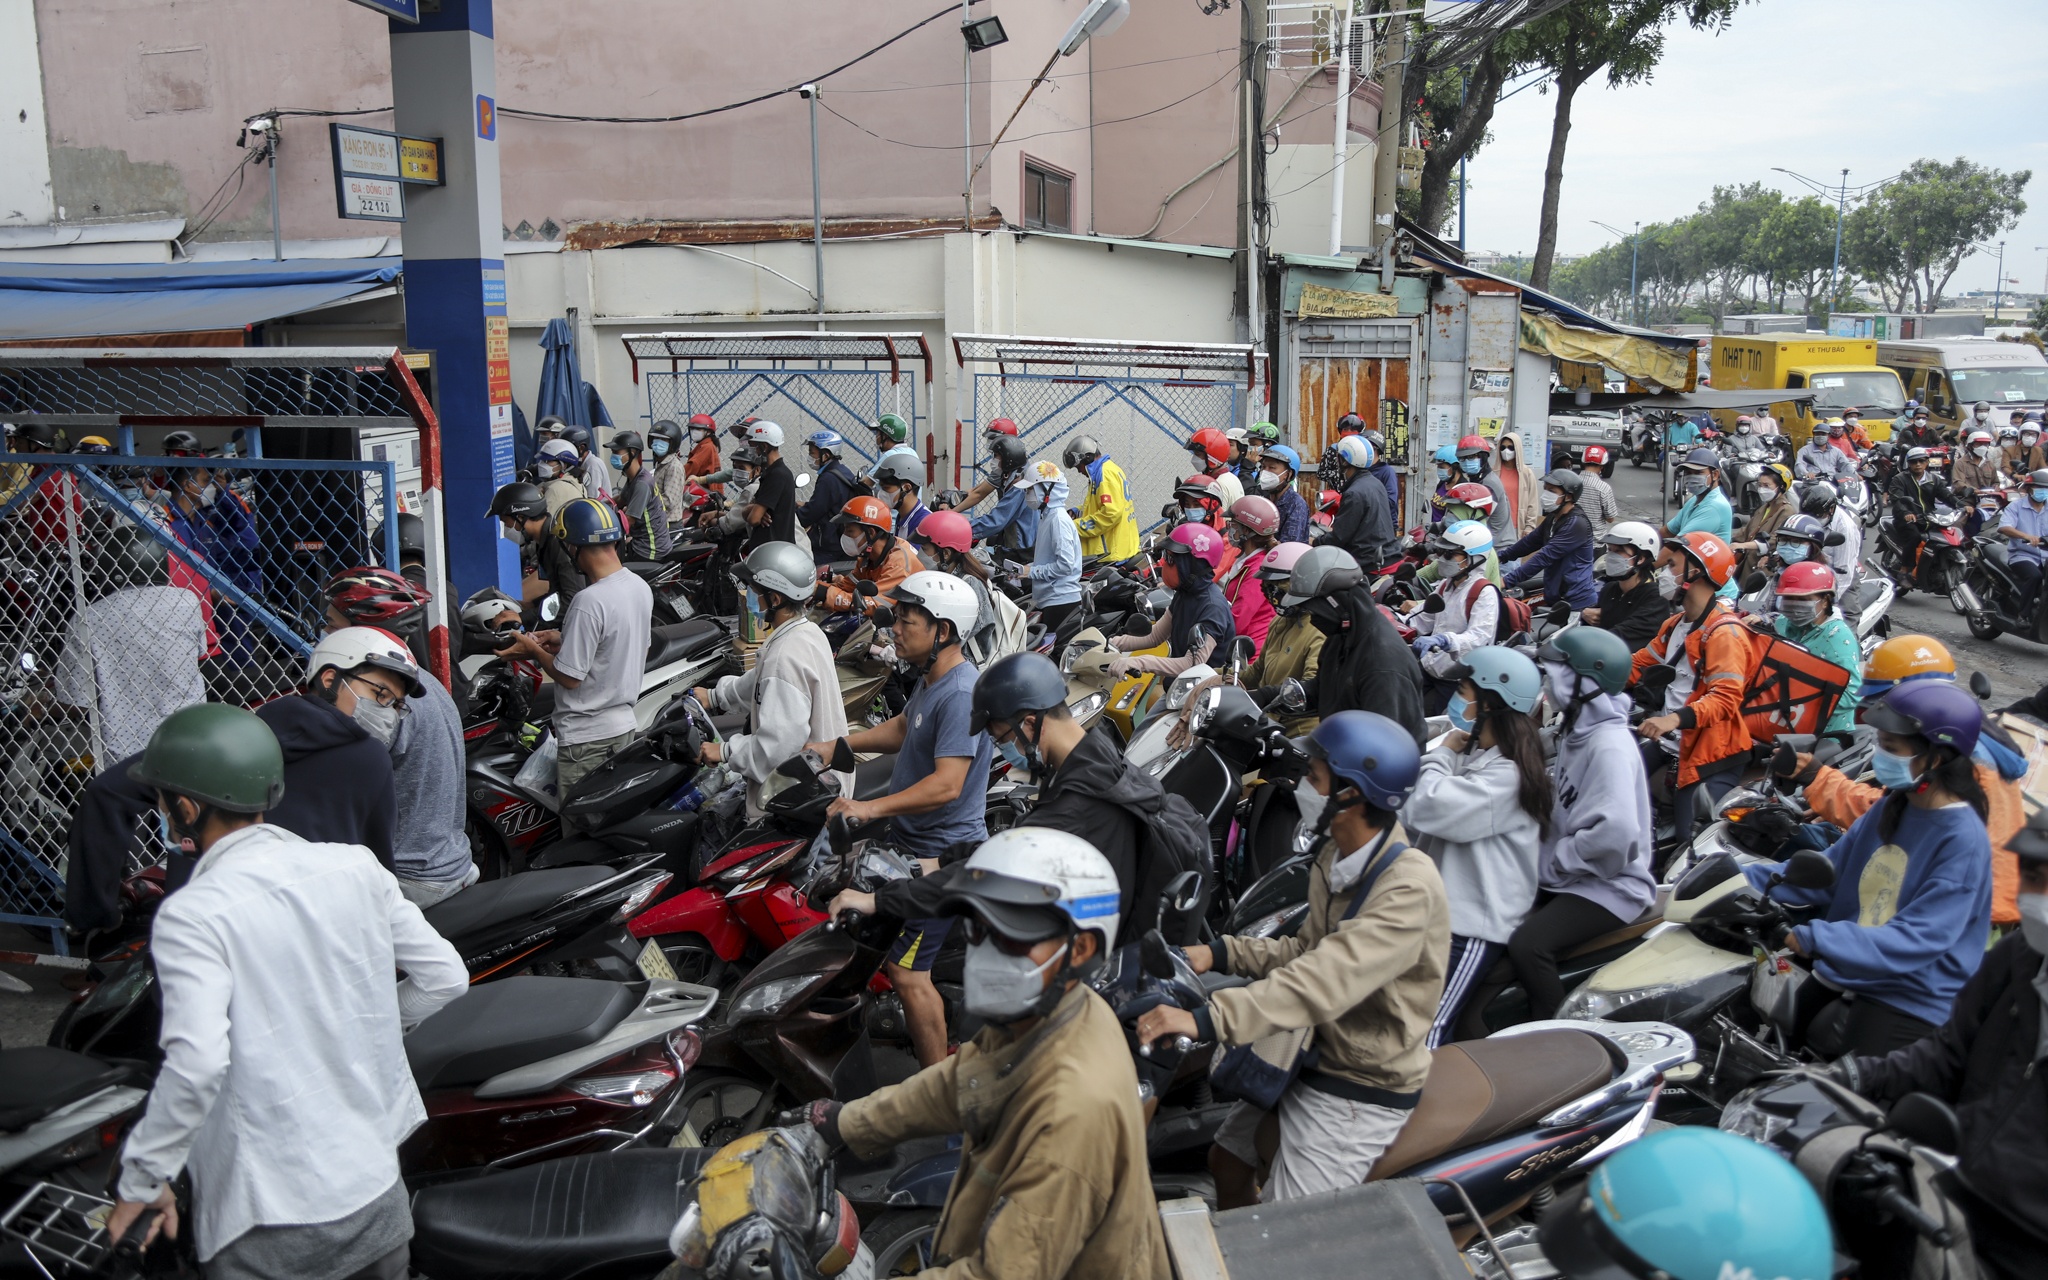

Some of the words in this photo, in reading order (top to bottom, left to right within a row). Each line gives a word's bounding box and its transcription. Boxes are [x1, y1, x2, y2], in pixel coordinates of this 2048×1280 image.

[363, 140, 378, 157] RON
[361, 200, 390, 214] 22120
[1306, 303, 1319, 312] BIA
[1961, 354, 2030, 362] LUXURY
[882, 423, 895, 435] Grab
[1910, 658, 1940, 667] AhaMove
[651, 818, 684, 834] HONDA
[779, 916, 811, 927] HONDA
[499, 1105, 577, 1124] LEAD
